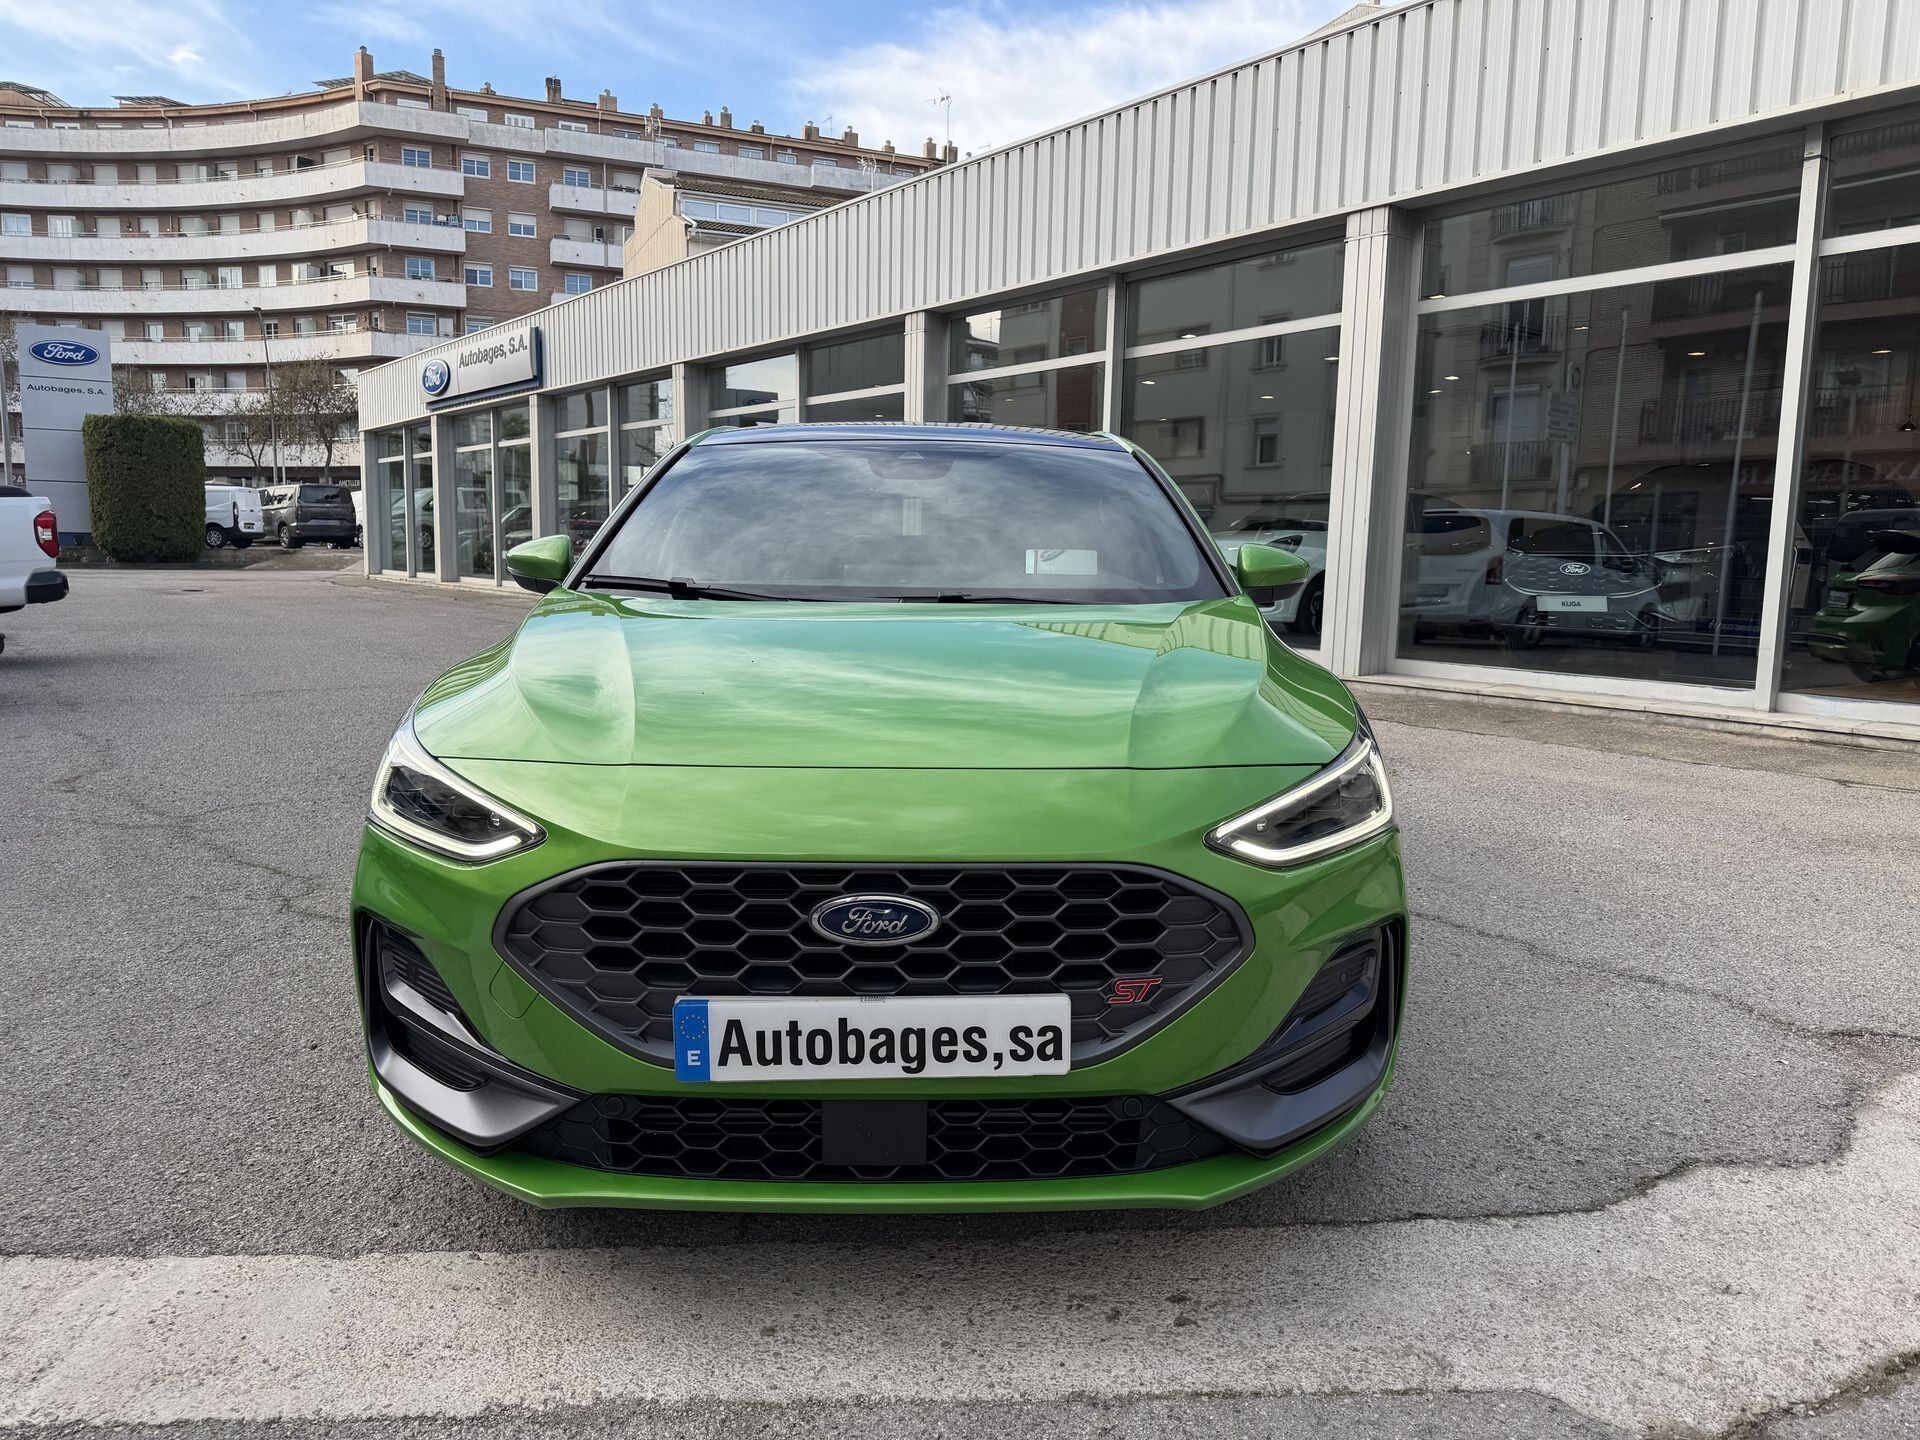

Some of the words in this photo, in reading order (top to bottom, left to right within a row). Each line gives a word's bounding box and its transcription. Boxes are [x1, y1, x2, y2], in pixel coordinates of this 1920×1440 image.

[43, 343, 85, 361] Ford
[459, 343, 507, 368] Autobages,
[508, 334, 528, 354] S.A.
[27, 384, 85, 394] Autobages,
[87, 388, 107, 396] S.A.
[1565, 564, 1584, 573] Ford
[1561, 600, 1582, 608] KUGA
[841, 906, 909, 934] Ford
[1108, 977, 1164, 1004] ST
[687, 1049, 702, 1066] E
